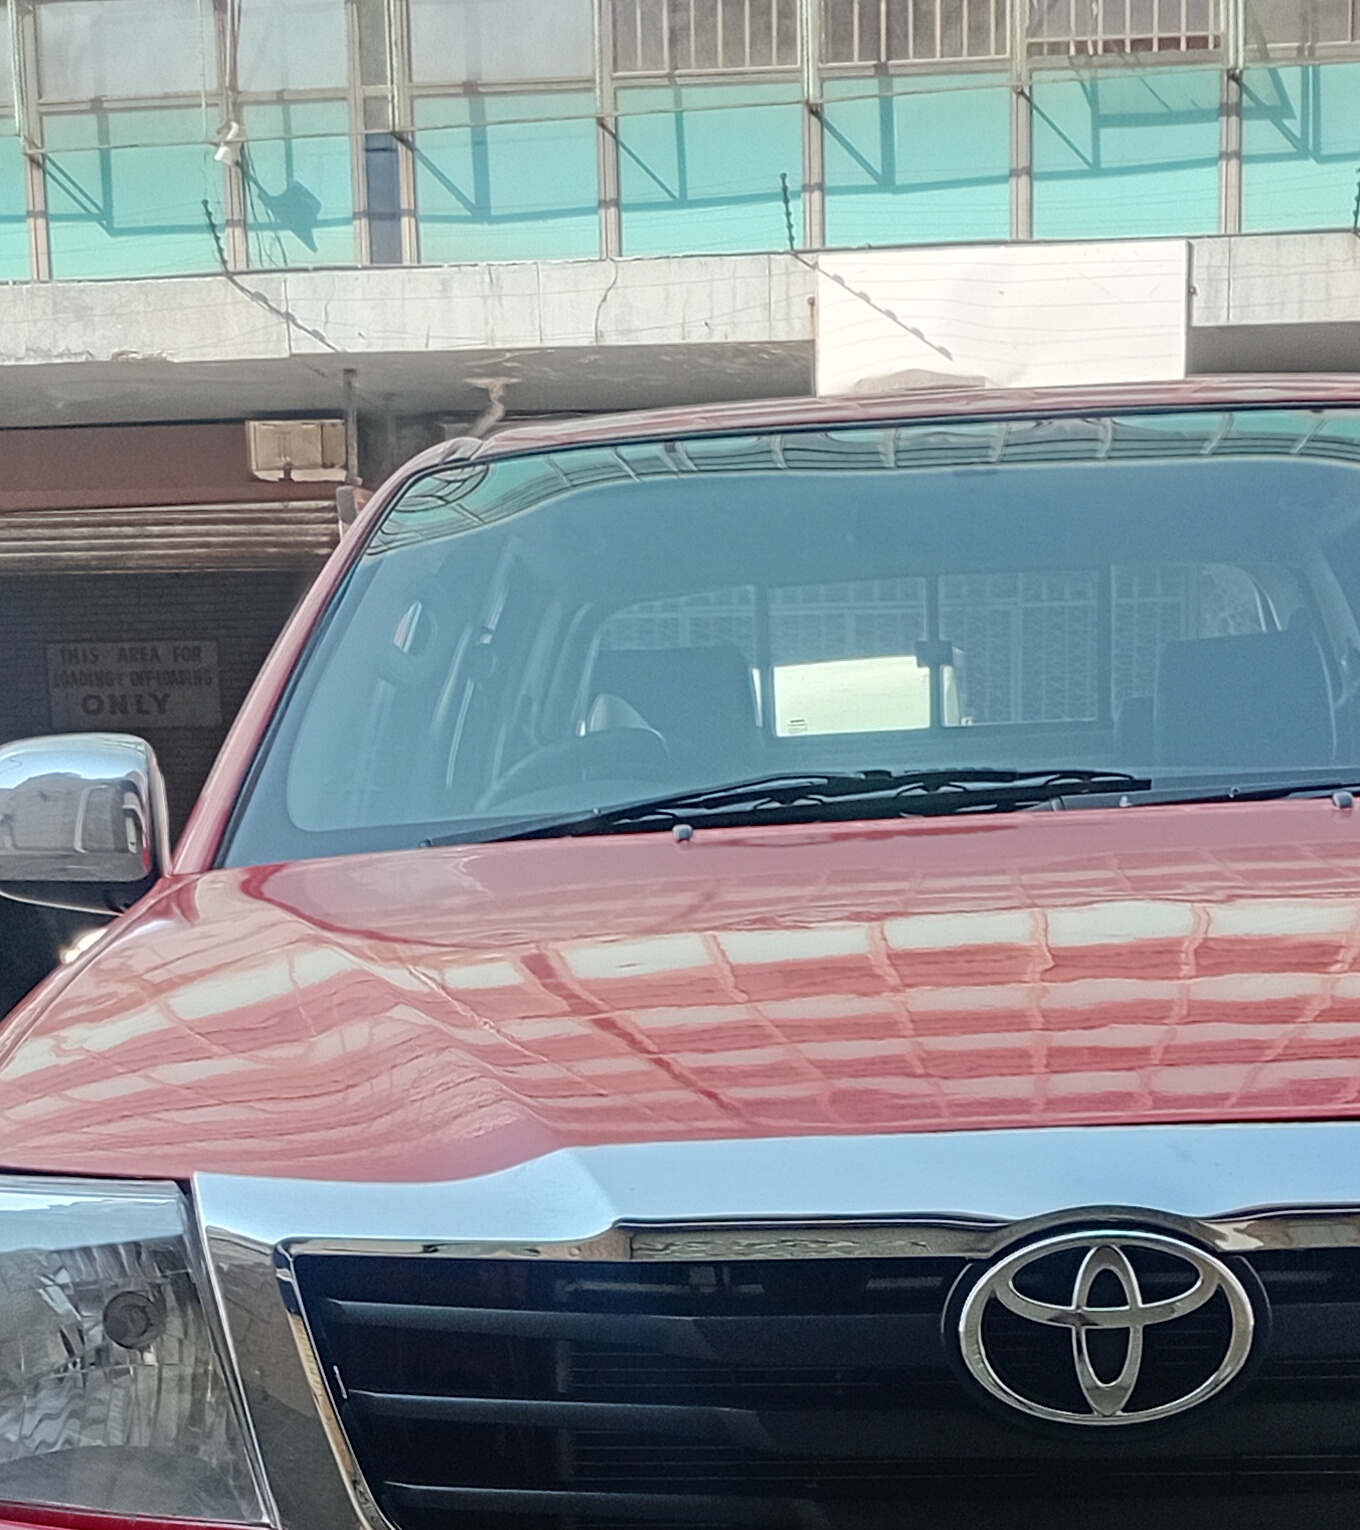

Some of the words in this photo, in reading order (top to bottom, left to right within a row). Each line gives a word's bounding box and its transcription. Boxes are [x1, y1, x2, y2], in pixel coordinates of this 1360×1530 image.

[60, 647, 99, 664] THIS
[118, 646, 161, 663] AREA
[172, 645, 202, 662] FOR
[81, 692, 172, 716] ONLY
